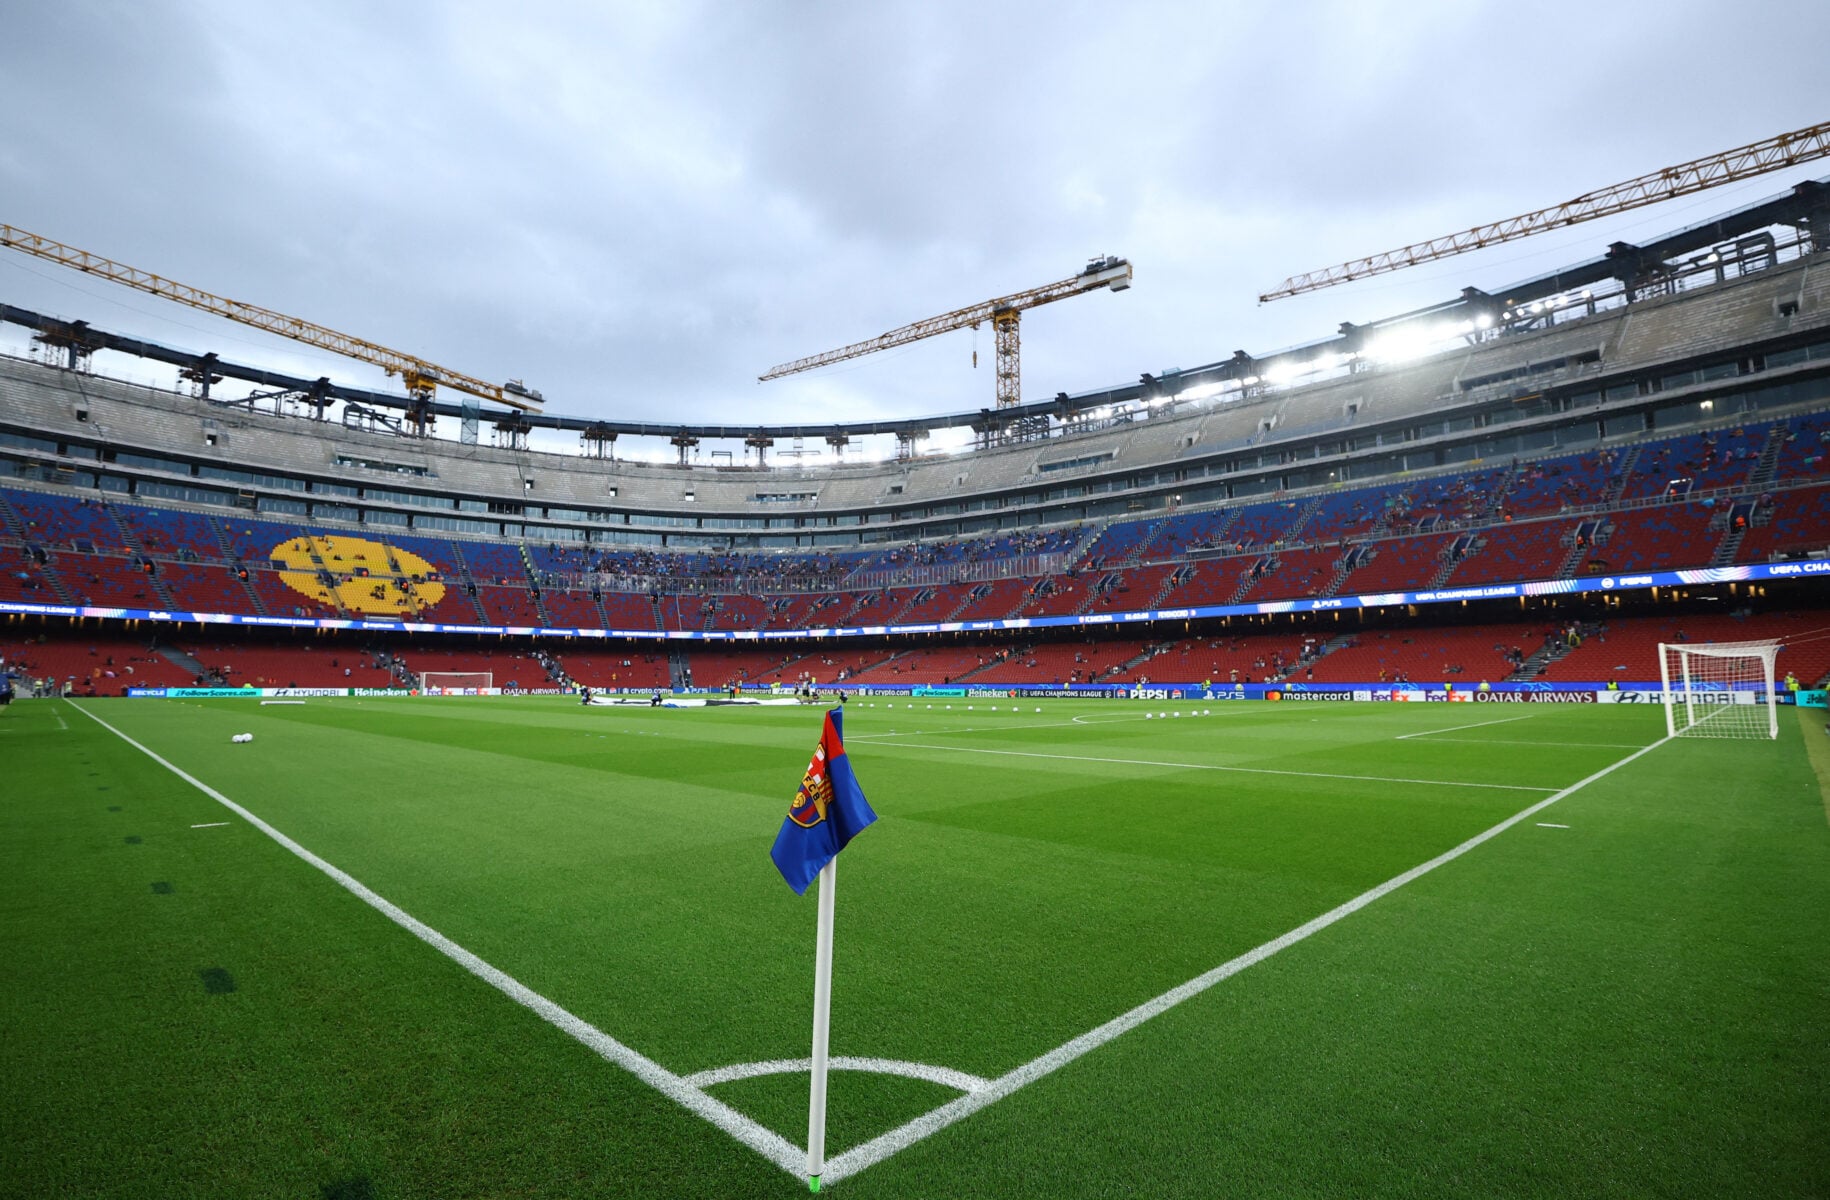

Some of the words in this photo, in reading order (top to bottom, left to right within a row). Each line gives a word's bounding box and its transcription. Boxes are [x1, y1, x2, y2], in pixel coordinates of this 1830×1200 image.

[1770, 565, 1801, 574] UEFA
[1436, 589, 1483, 599] CHAMPIONS
[1484, 587, 1516, 596] LEAGUE
[354, 688, 408, 696] Heineken
[968, 689, 1008, 697] Heineken
[1080, 691, 1102, 699] LEAGUE
[1130, 690, 1168, 699] PEPSI
[1217, 691, 1245, 699] PS5
[1283, 691, 1351, 700] mastercard
[1371, 691, 1409, 701] FedEx
[1426, 691, 1467, 701] FedEx
[1477, 692, 1523, 702] QATAR
[1529, 692, 1592, 702] AIRWAYS
[1650, 693, 1735, 704] HUNDAI
